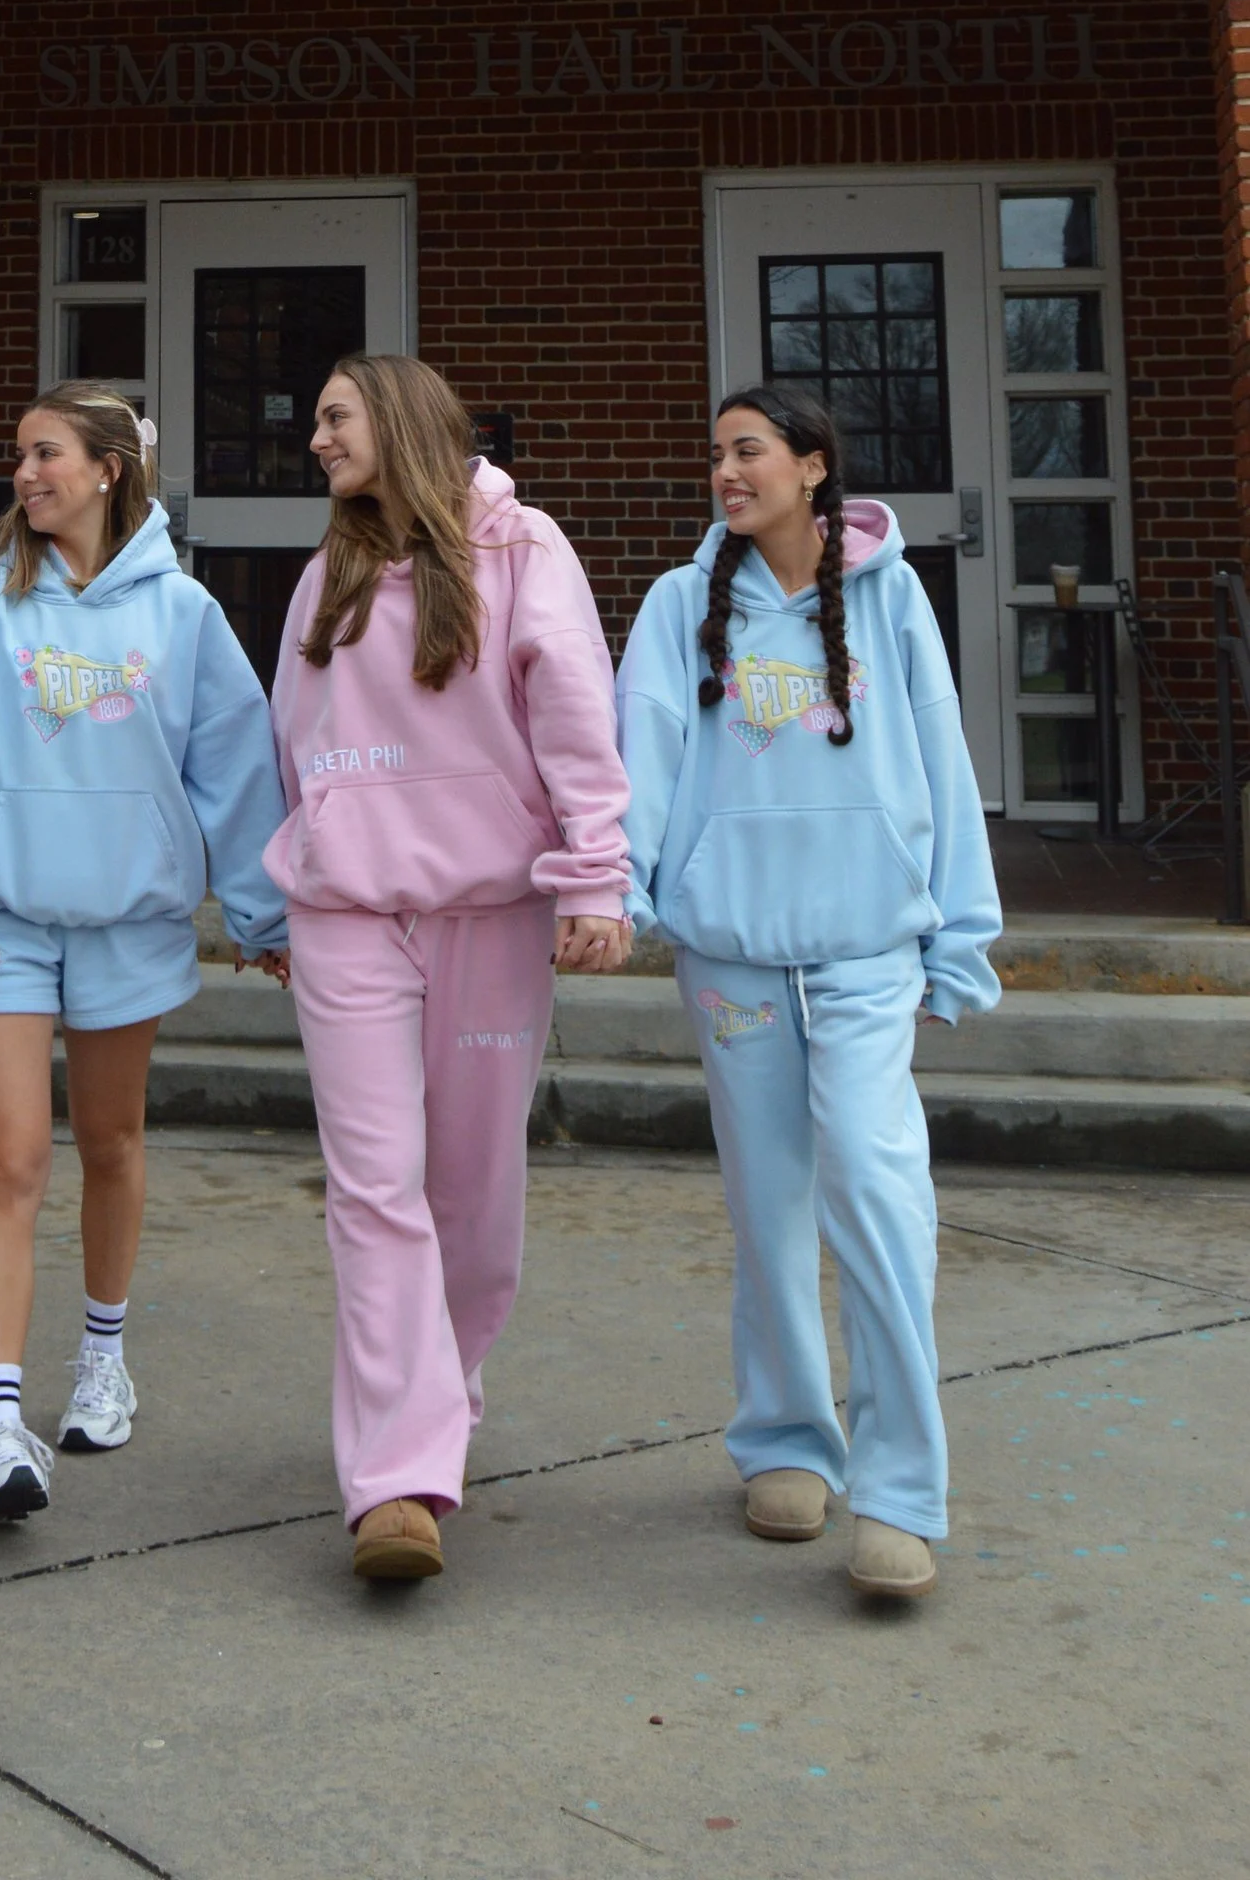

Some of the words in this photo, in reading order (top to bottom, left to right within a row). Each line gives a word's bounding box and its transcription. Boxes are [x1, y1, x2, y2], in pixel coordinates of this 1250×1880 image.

[36, 33, 423, 109] SIMPSON
[468, 26, 717, 97] HALL
[752, 13, 1104, 92] NORTH
[85, 235, 137, 264] 128
[44, 662, 74, 710] PI
[77, 667, 125, 701] PHI
[747, 673, 783, 723] PI
[785, 674, 831, 711] PH
[99, 696, 127, 720] 1867
[313, 747, 362, 774] BETA
[368, 744, 405, 771] PHI
